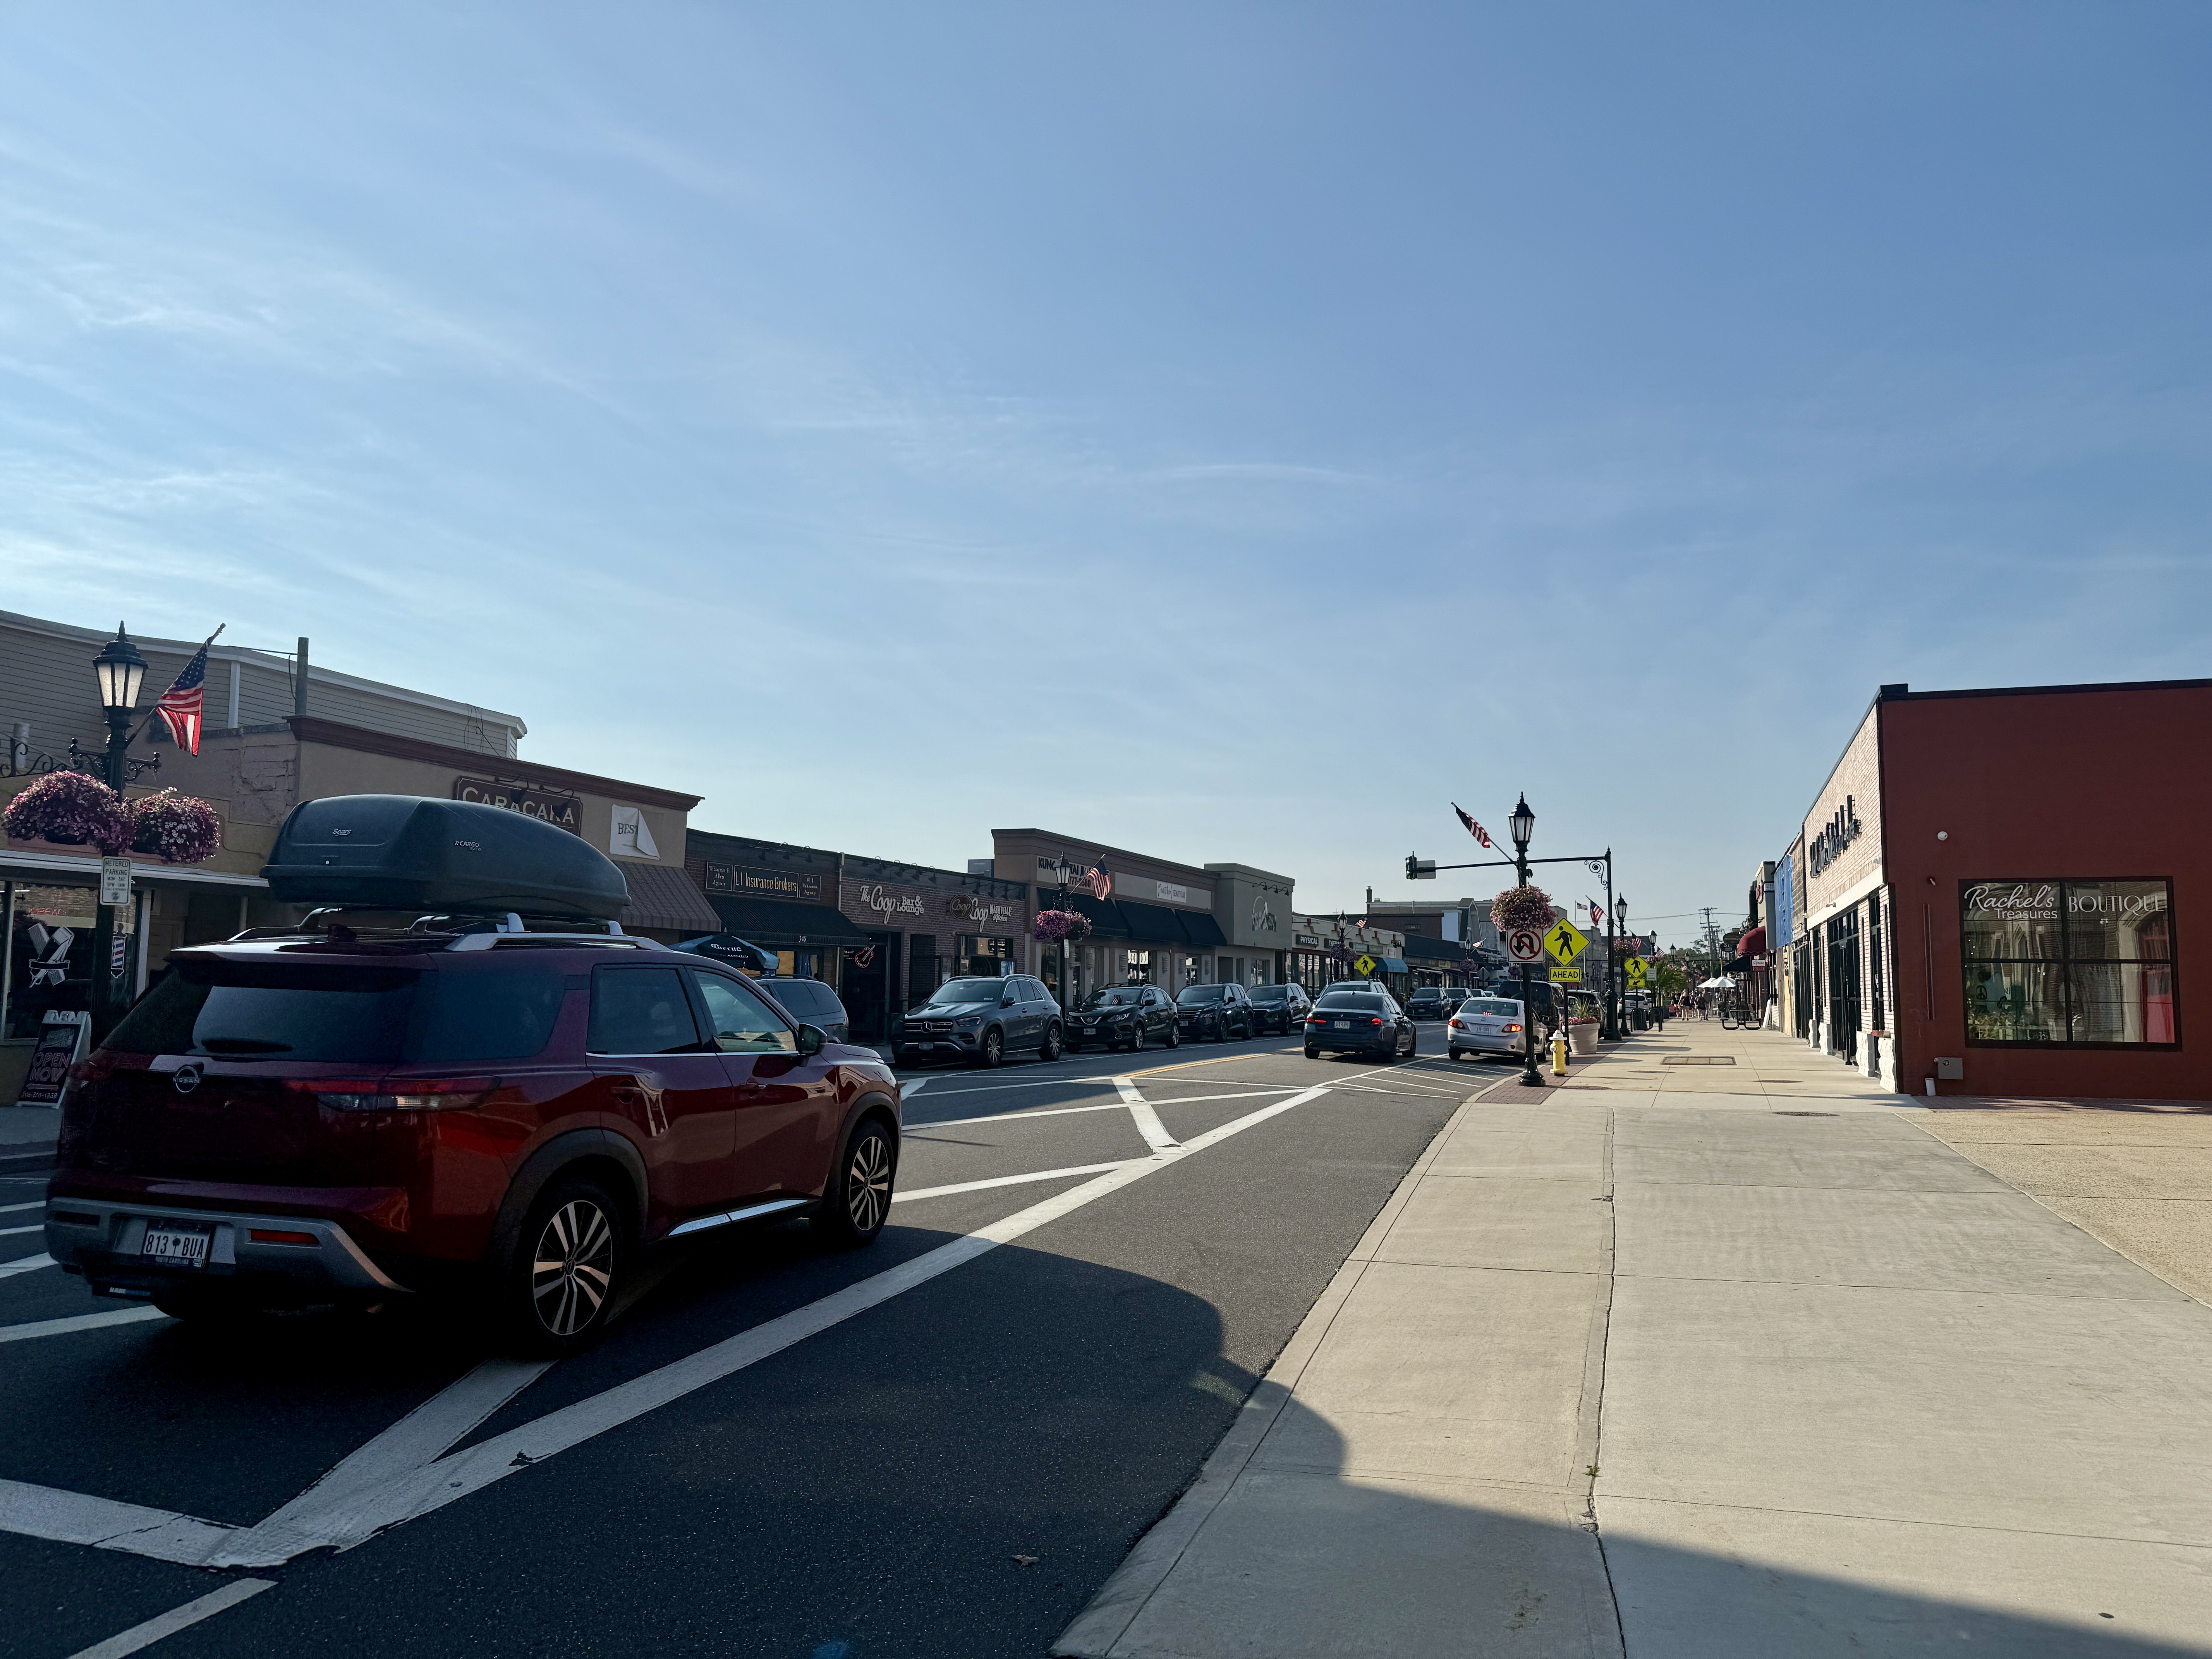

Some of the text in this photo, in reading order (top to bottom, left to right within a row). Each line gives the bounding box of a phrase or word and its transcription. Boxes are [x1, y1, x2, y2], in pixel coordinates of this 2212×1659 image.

[745, 872, 773, 890] Insurance
[775, 876, 797, 892] Brokers
[860, 885, 896, 925] The Coop
[1964, 884, 2054, 912] Rachel's
[2068, 895, 2164, 916] BOUTIQUE
[896, 902, 924, 915] Lounge
[952, 899, 971, 916] Coop
[989, 904, 1012, 917] NASHVILLE
[1994, 908, 2057, 919] Treasures
[1300, 936, 1318, 945] PHYSICAL
[33, 1052, 72, 1068] OPEN
[29, 1067, 65, 1082] NOW
[146, 1234, 204, 1258] 813 BUA
